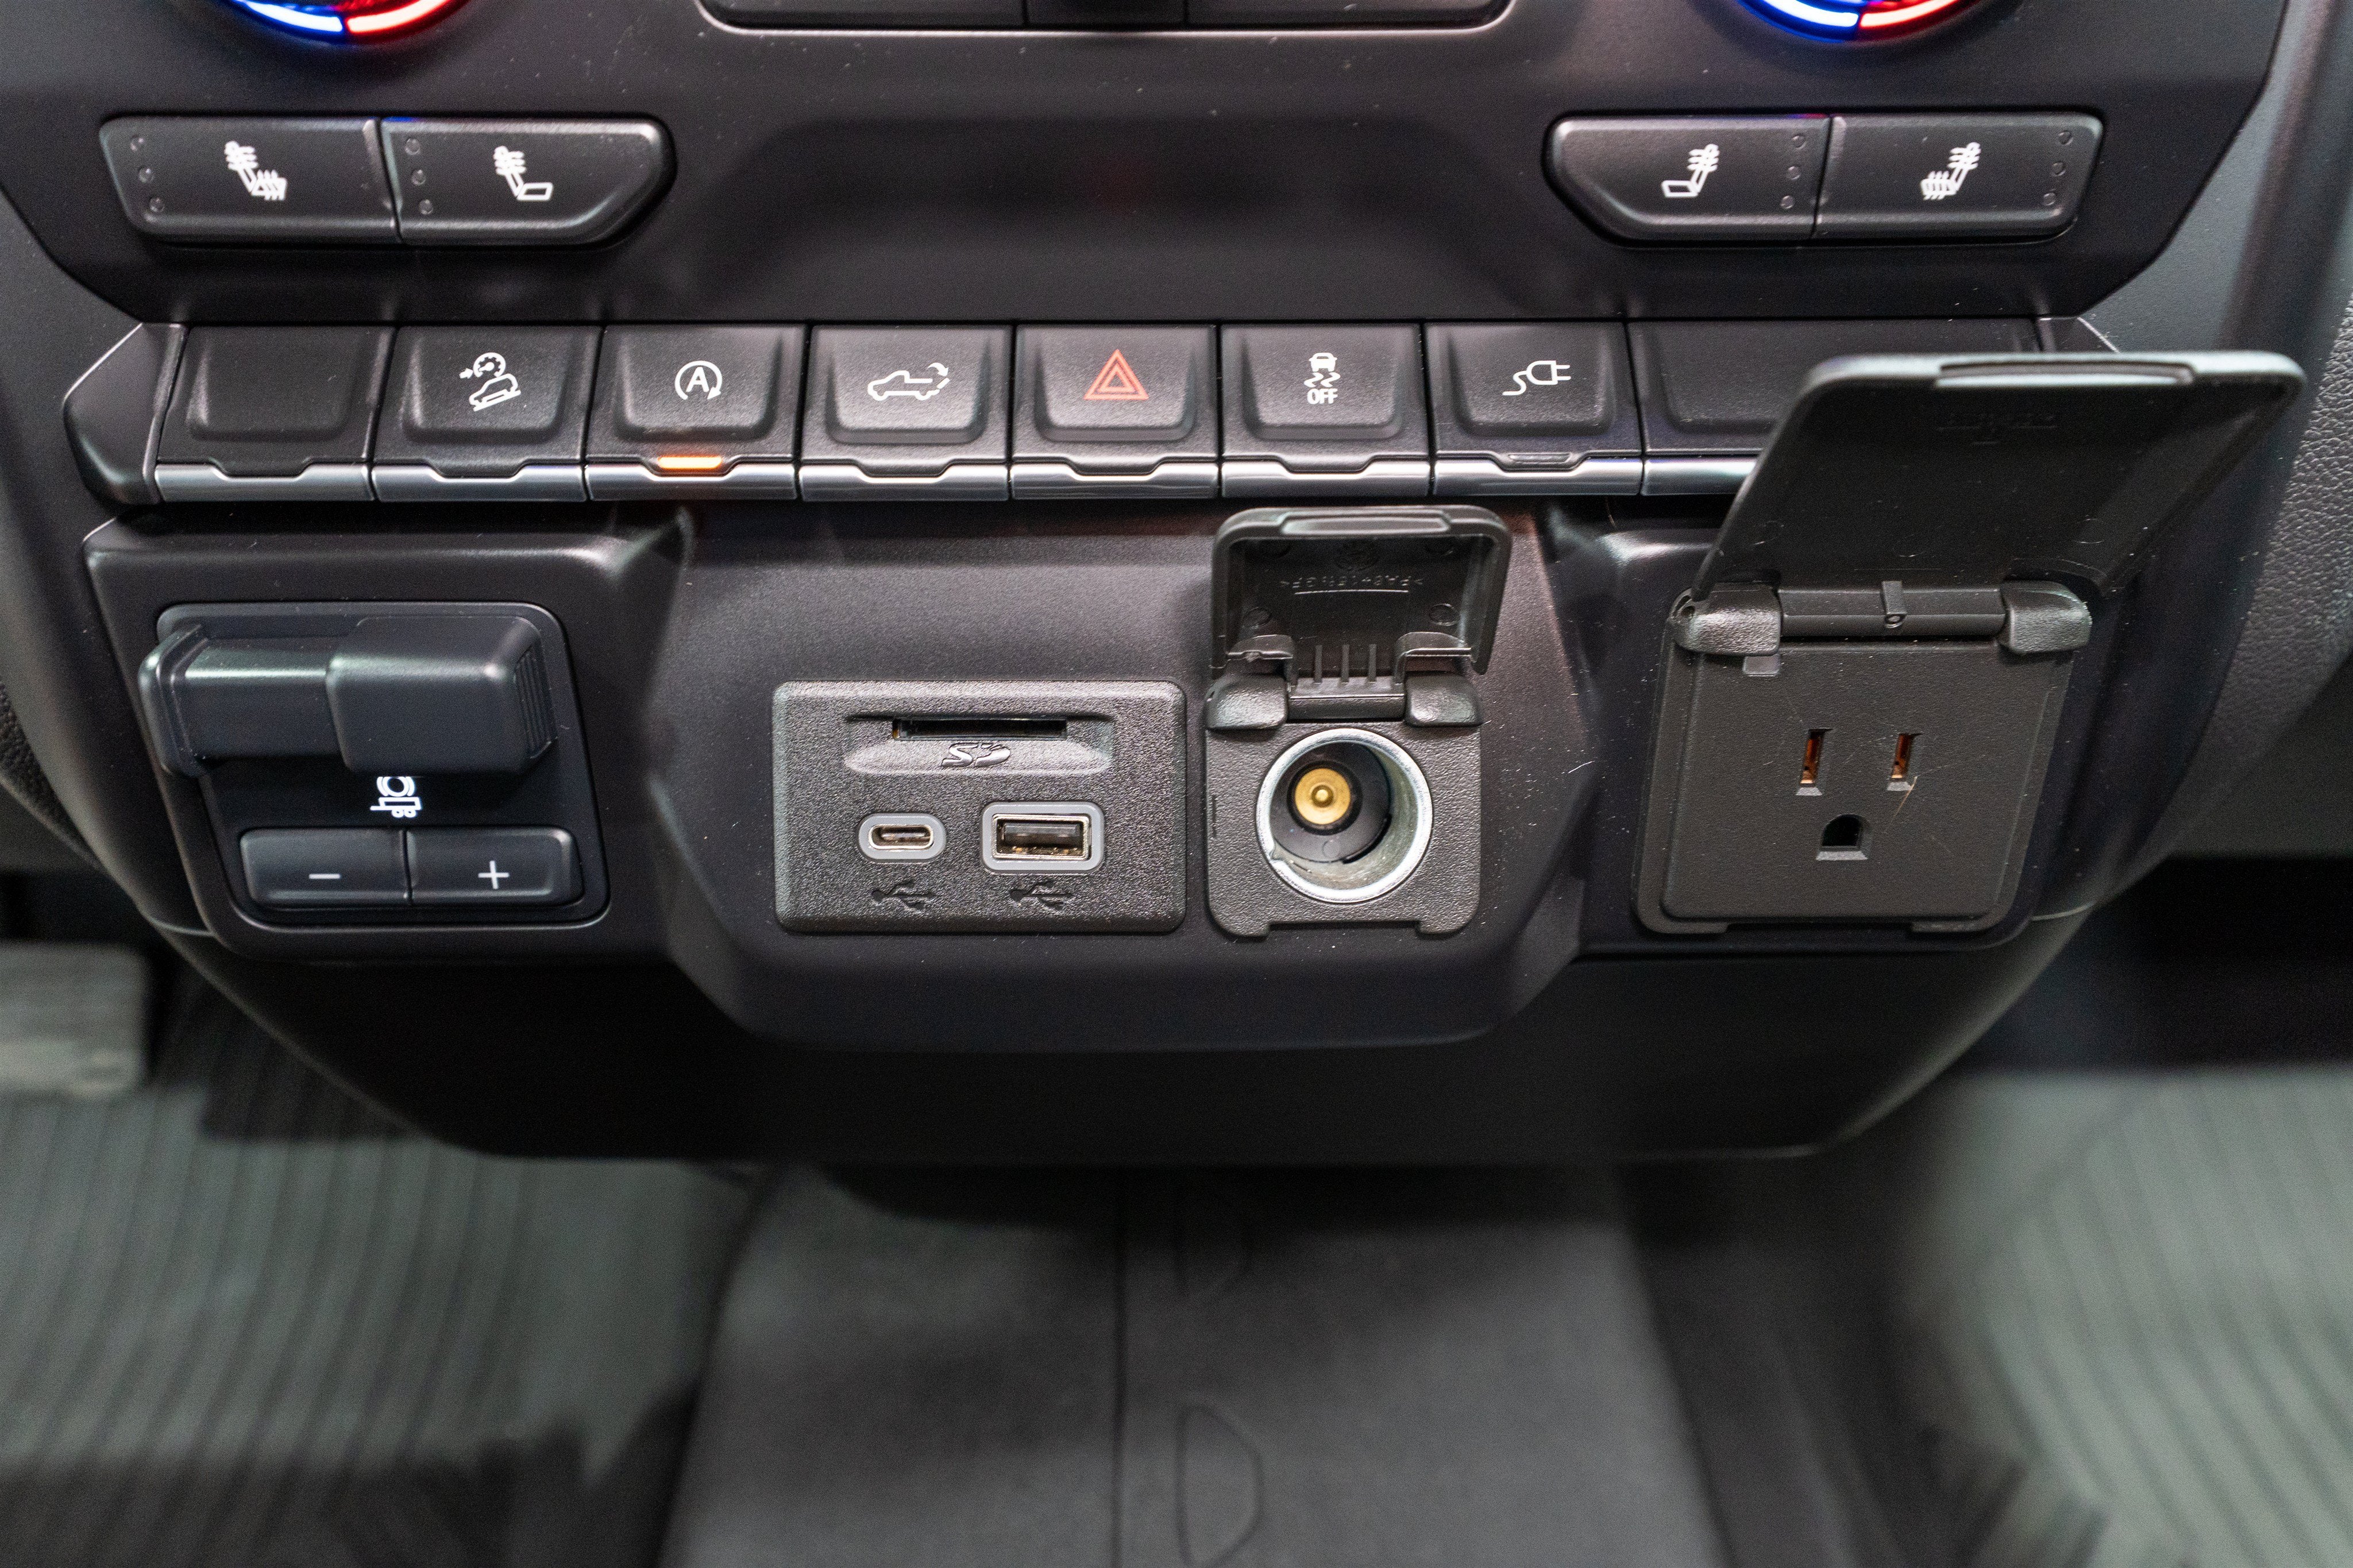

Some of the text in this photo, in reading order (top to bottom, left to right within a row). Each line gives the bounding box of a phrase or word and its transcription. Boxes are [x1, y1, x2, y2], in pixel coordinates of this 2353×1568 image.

[686, 366, 709, 392] A
[1307, 388, 1338, 404] OFF
[941, 741, 1011, 767] SD
